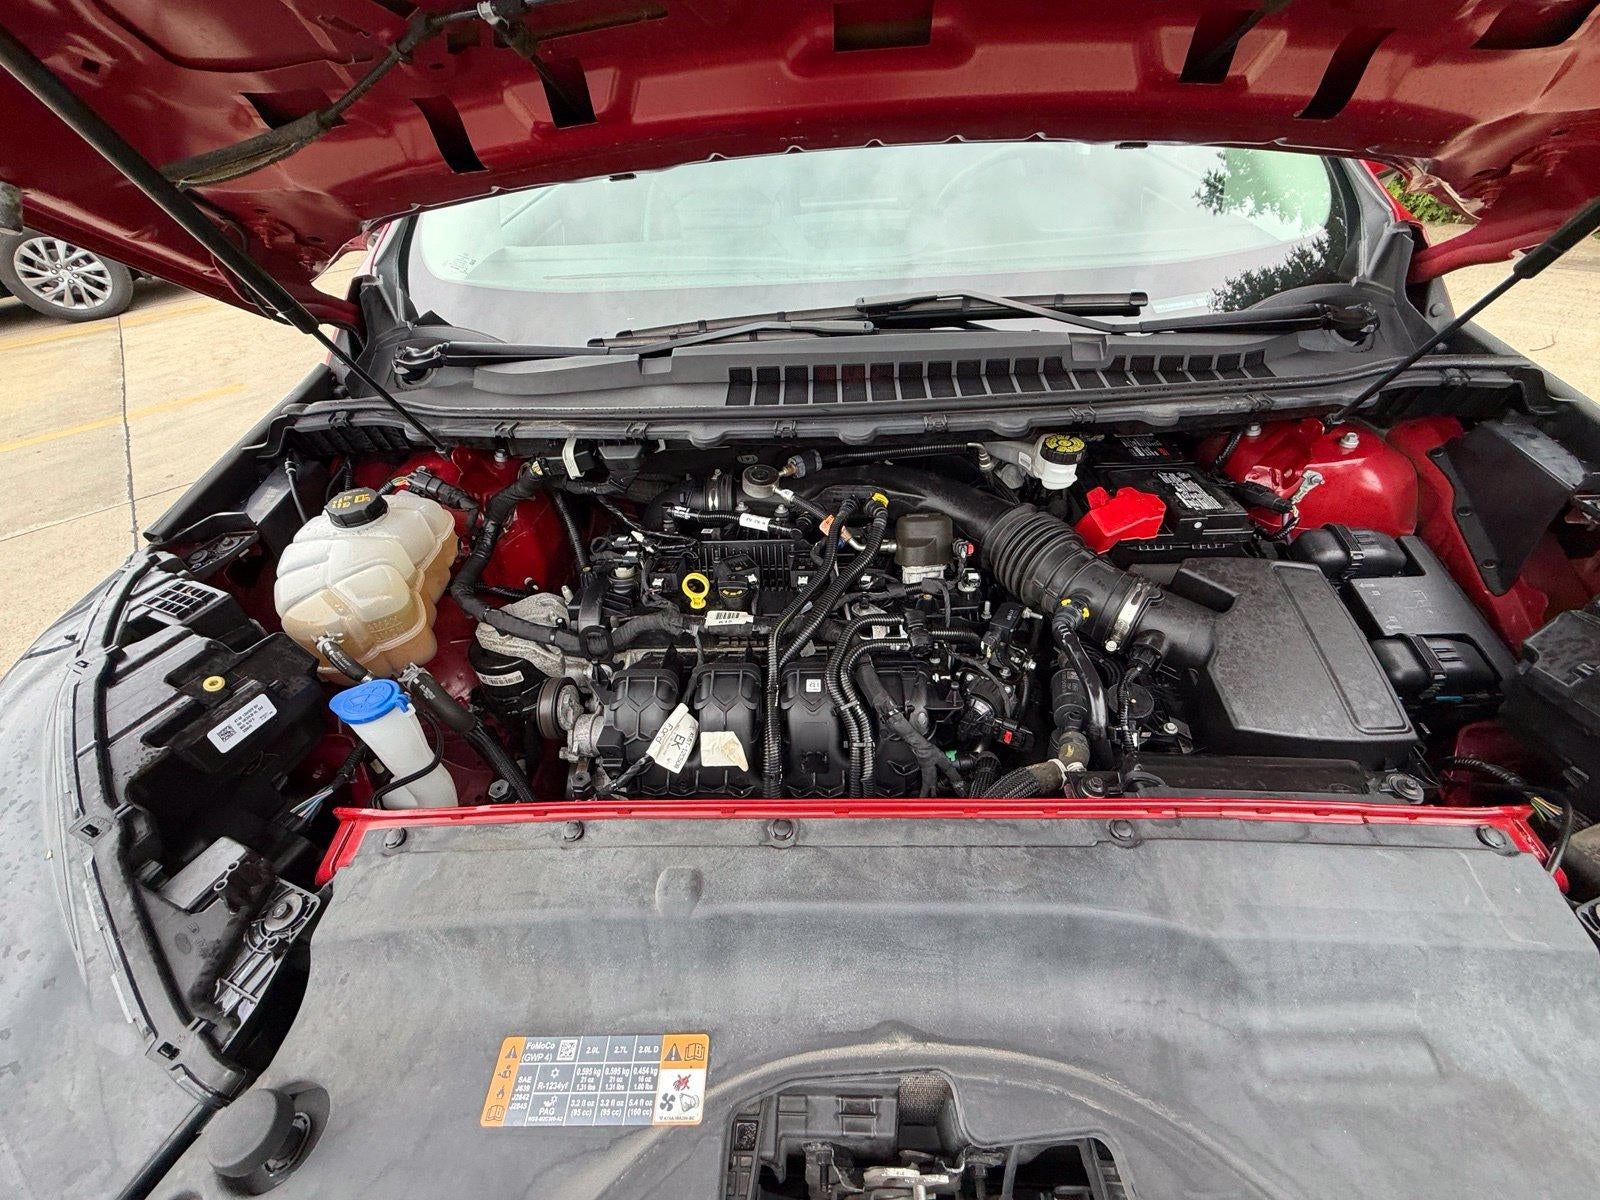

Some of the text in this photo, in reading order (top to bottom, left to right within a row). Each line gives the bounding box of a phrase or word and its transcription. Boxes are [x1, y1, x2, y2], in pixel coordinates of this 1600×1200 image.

[655, 723, 674, 745] Ford
[670, 733, 686, 750] EK
[525, 1041, 556, 1050] FoMoCo
[586, 1046, 600, 1054] 2.0L
[614, 1046, 628, 1054] 2.7L
[638, 1046, 652, 1054] 2.0L
[521, 1053, 553, 1063] (GWP 4)
[593, 1067, 601, 1077] kg
[622, 1067, 630, 1077] kg
[633, 1067, 658, 1077] 0.454 kg
[537, 1082, 569, 1091] R-1234yf
[570, 1099, 580, 1107] 3.2
[600, 1099, 610, 1107] 3.2
[581, 1109, 592, 1117] cc)
[611, 1109, 622, 1117] cc)
[642, 1108, 652, 1117] cc)
